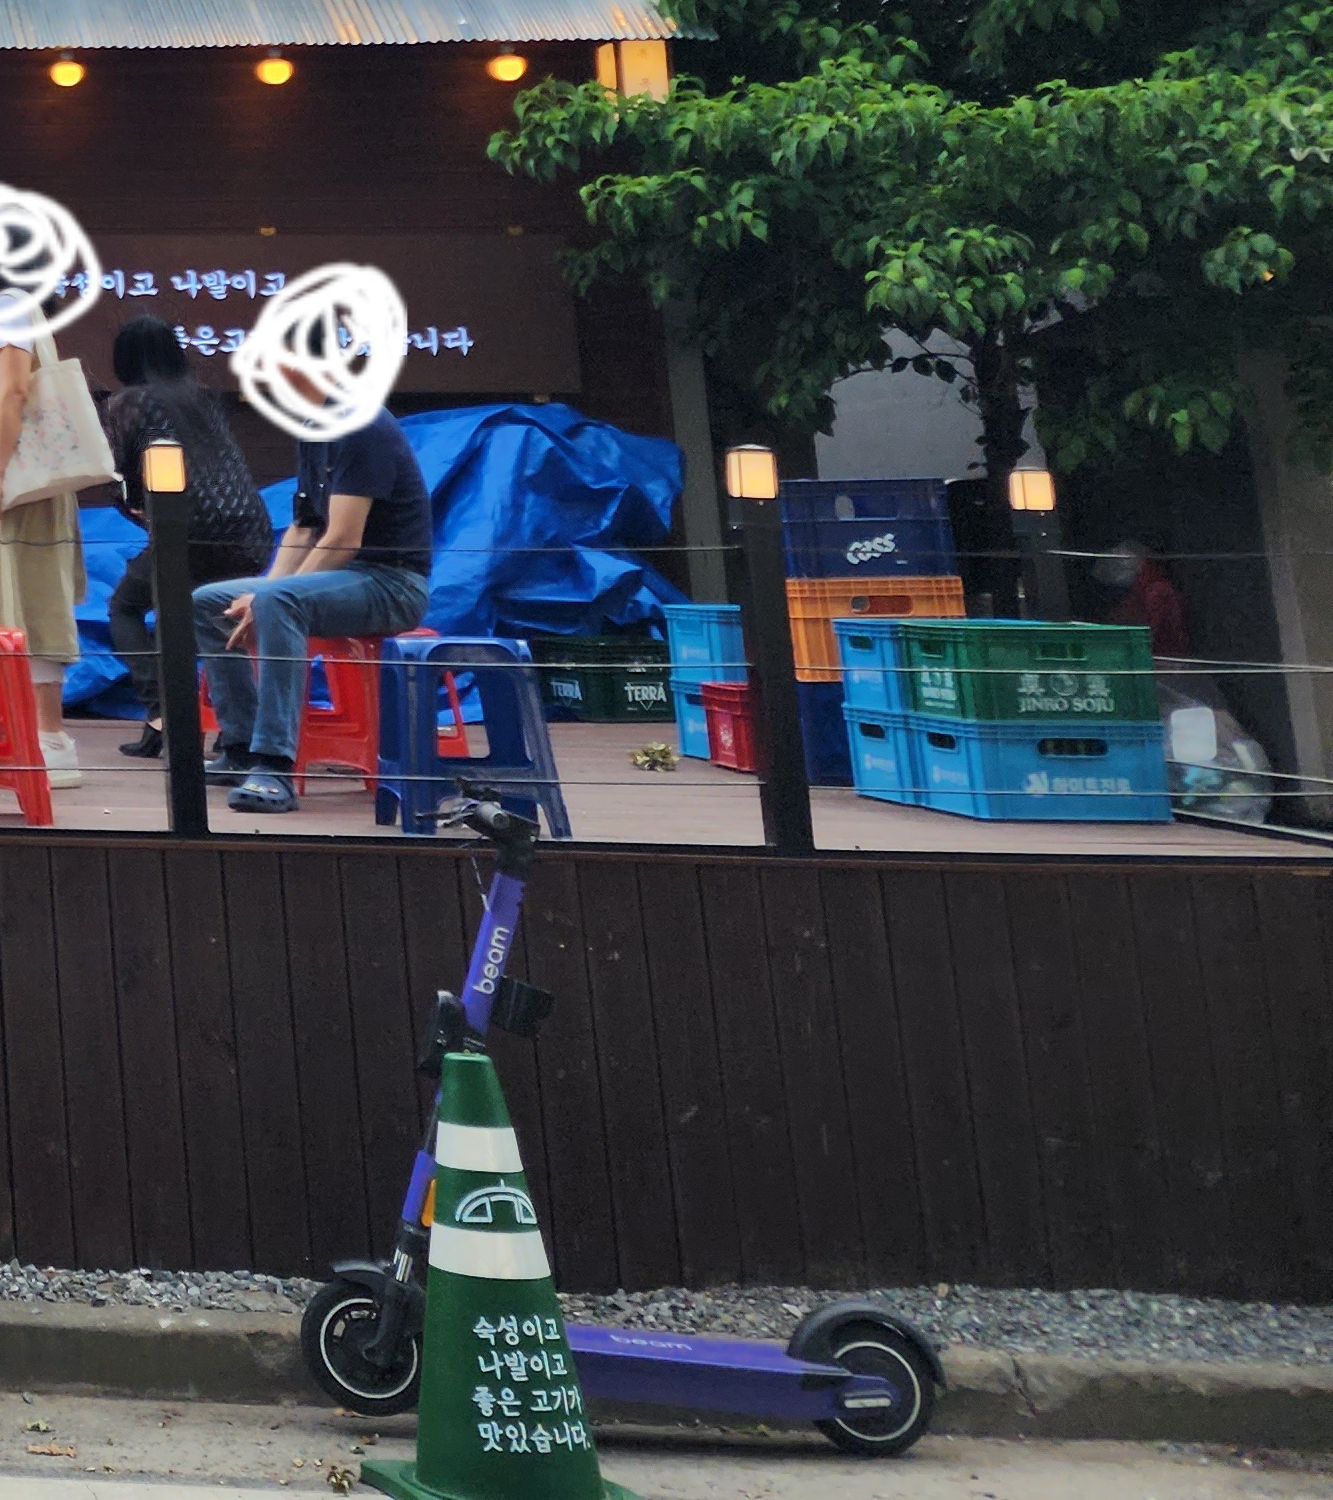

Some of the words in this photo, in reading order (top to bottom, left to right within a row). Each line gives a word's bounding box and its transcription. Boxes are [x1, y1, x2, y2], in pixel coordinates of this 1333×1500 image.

[170, 269, 287, 300] 나발이고
[549, 679, 583, 701] TERRA
[623, 682, 668, 703] TERRA
[1018, 697, 1070, 713] JINRO
[1072, 697, 1115, 713] SOJU
[472, 926, 511, 995] beam
[472, 1315, 561, 1346] 숙성이고
[478, 1349, 568, 1382] 나발이고
[472, 1385, 522, 1417] 좋은
[530, 1385, 583, 1416] 고기가
[477, 1420, 592, 1454] 맛있습니다.
